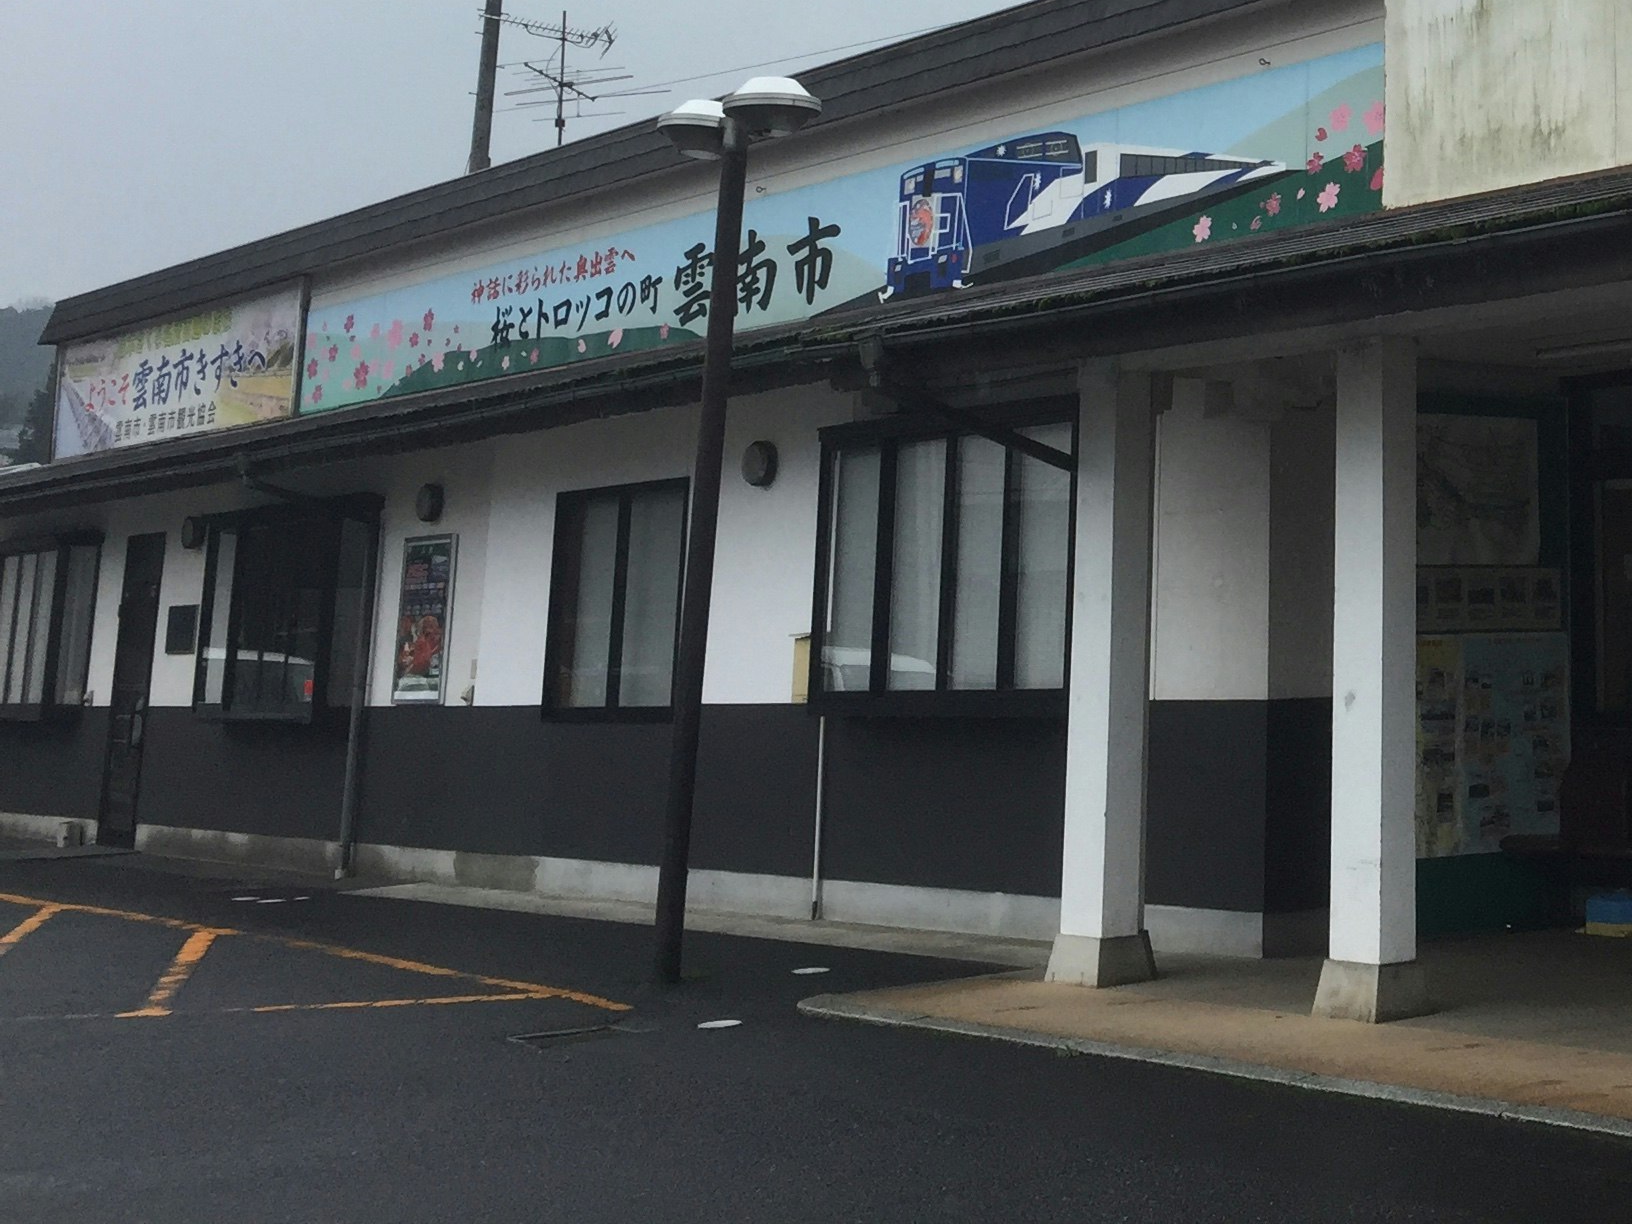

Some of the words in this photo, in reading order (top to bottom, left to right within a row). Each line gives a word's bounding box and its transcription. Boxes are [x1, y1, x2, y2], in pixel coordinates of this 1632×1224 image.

[470, 246, 636, 306] 神話に彩られた奥出雲へ
[490, 273, 664, 356] 桜とトロッコの町
[673, 216, 842, 329] 雲南市
[132, 340, 267, 411] 雲南市きすきへ
